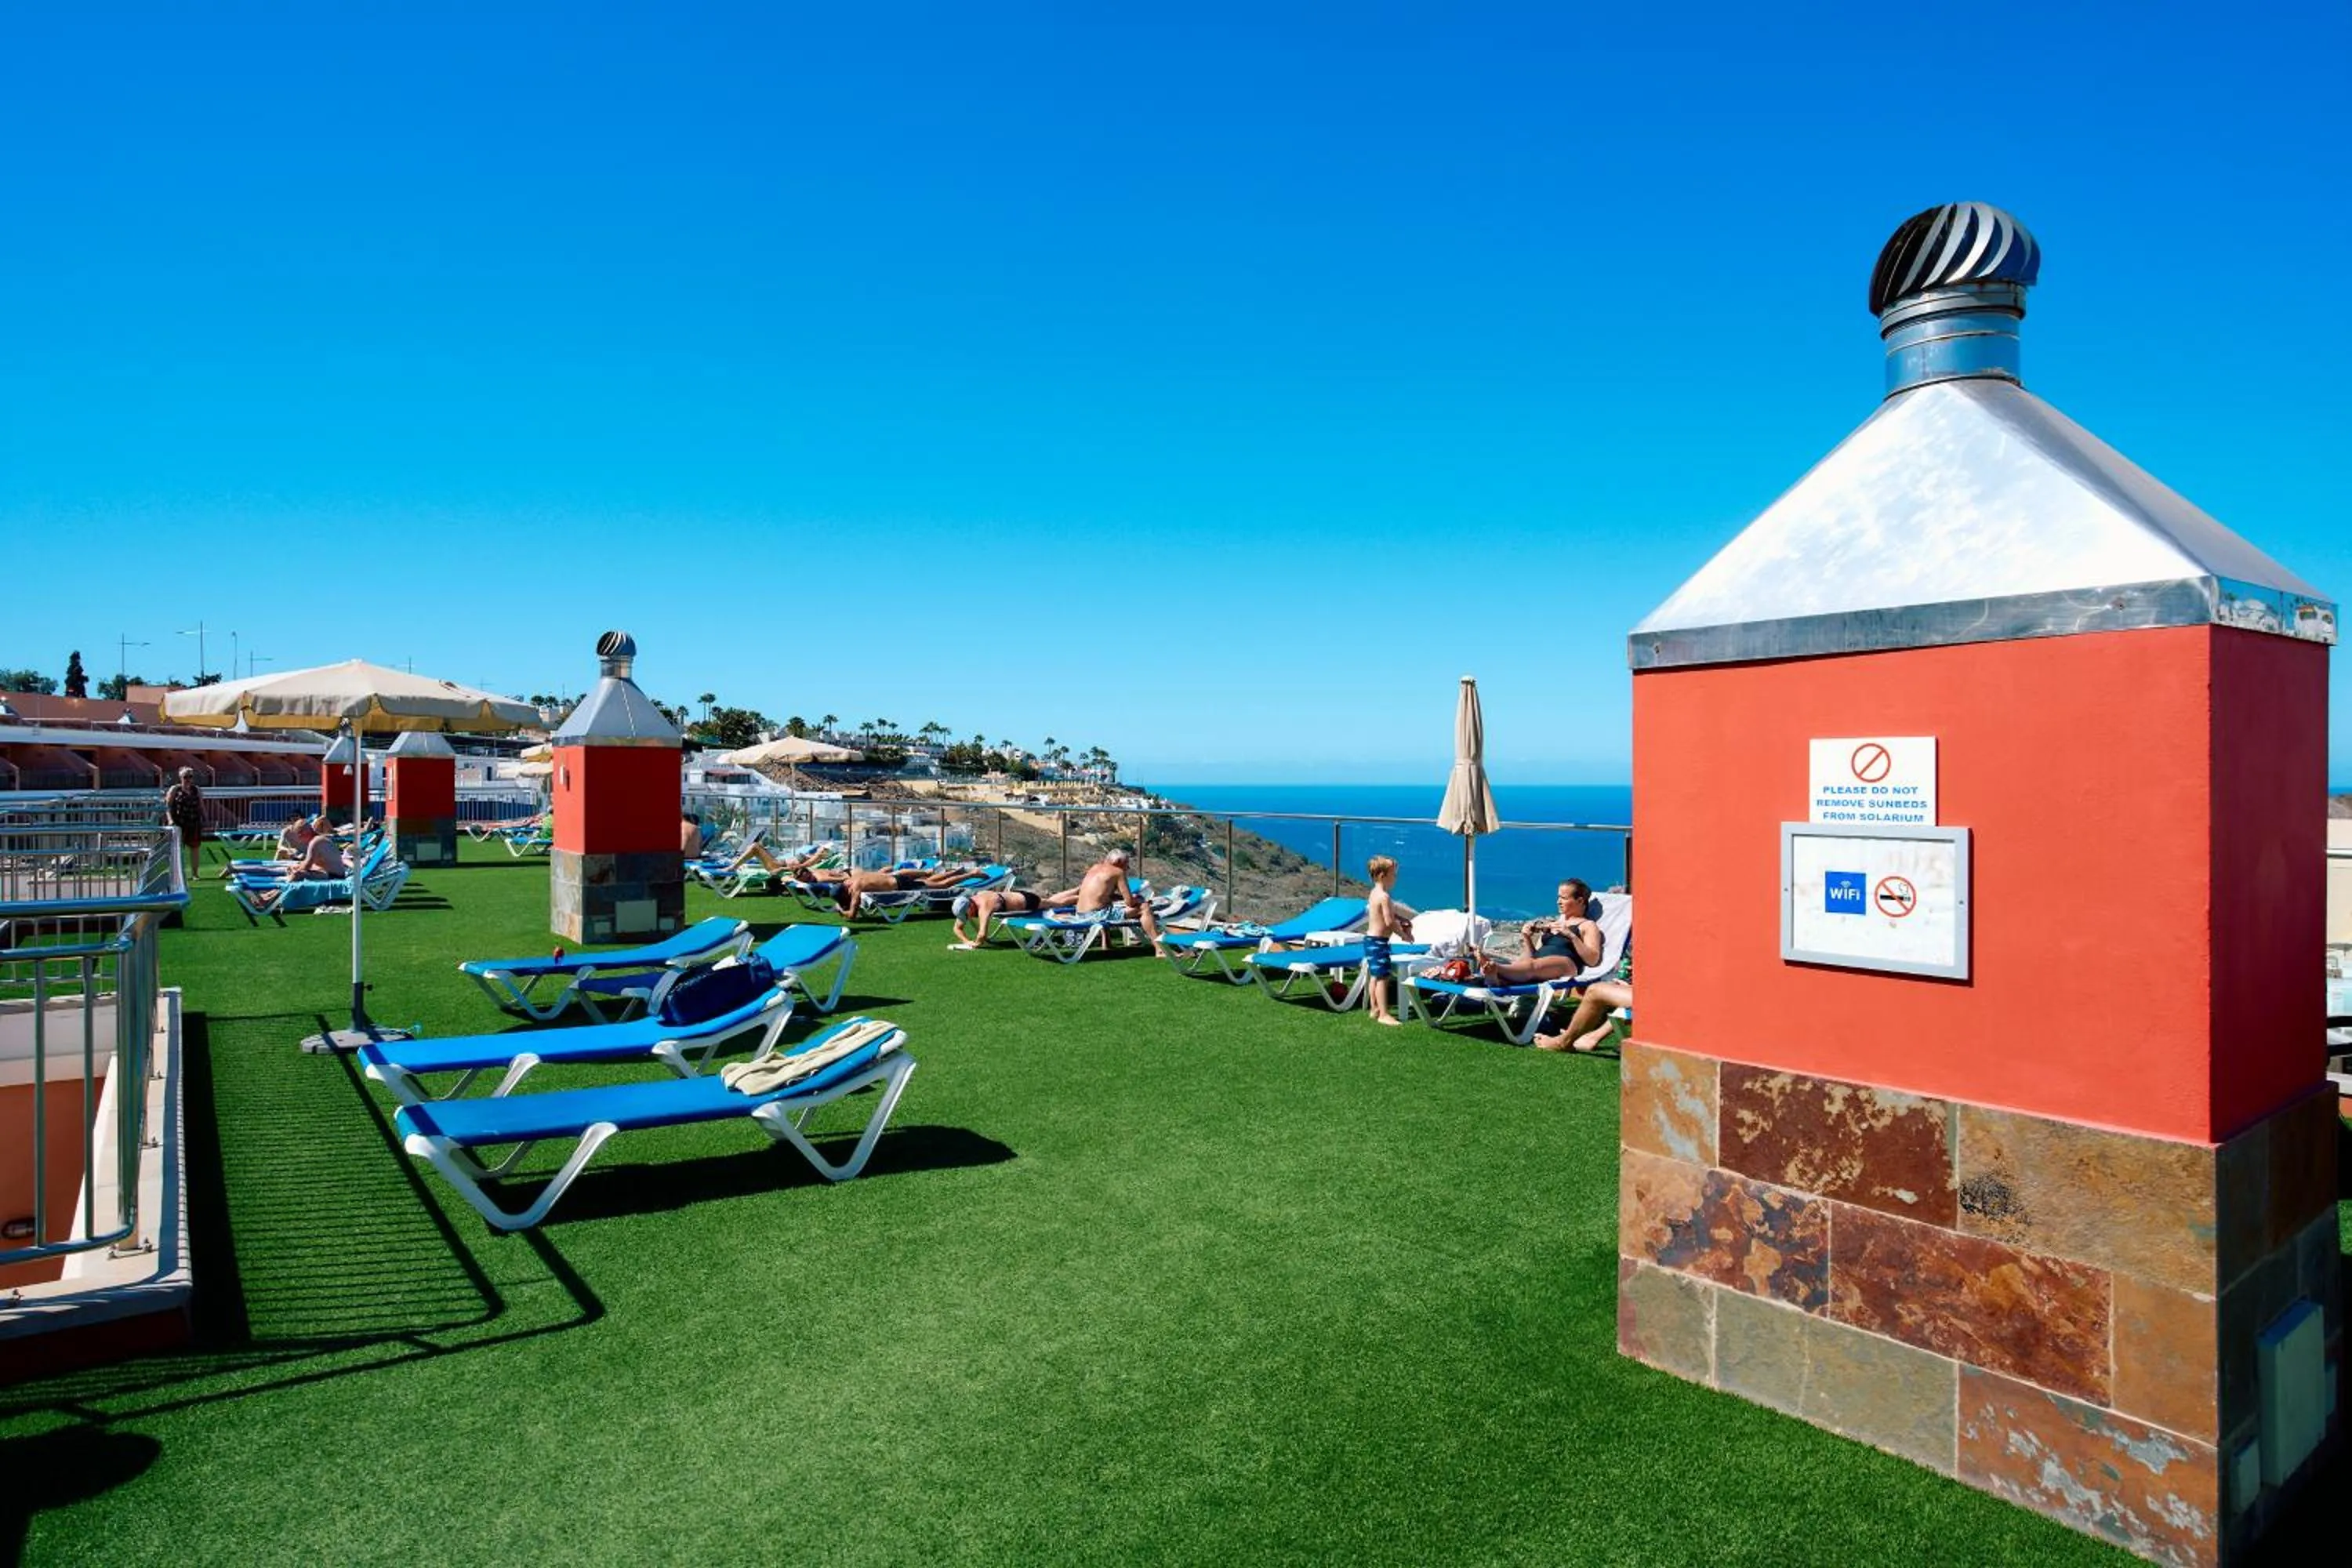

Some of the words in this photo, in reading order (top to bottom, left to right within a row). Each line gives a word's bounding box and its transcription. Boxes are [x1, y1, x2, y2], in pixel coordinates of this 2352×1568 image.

[1817, 799, 1865, 808] REMOVE
[1869, 800, 1928, 808] SUNBEDS
[1823, 811, 1856, 820] FROM
[1860, 813, 1924, 822] SOLARIUM
